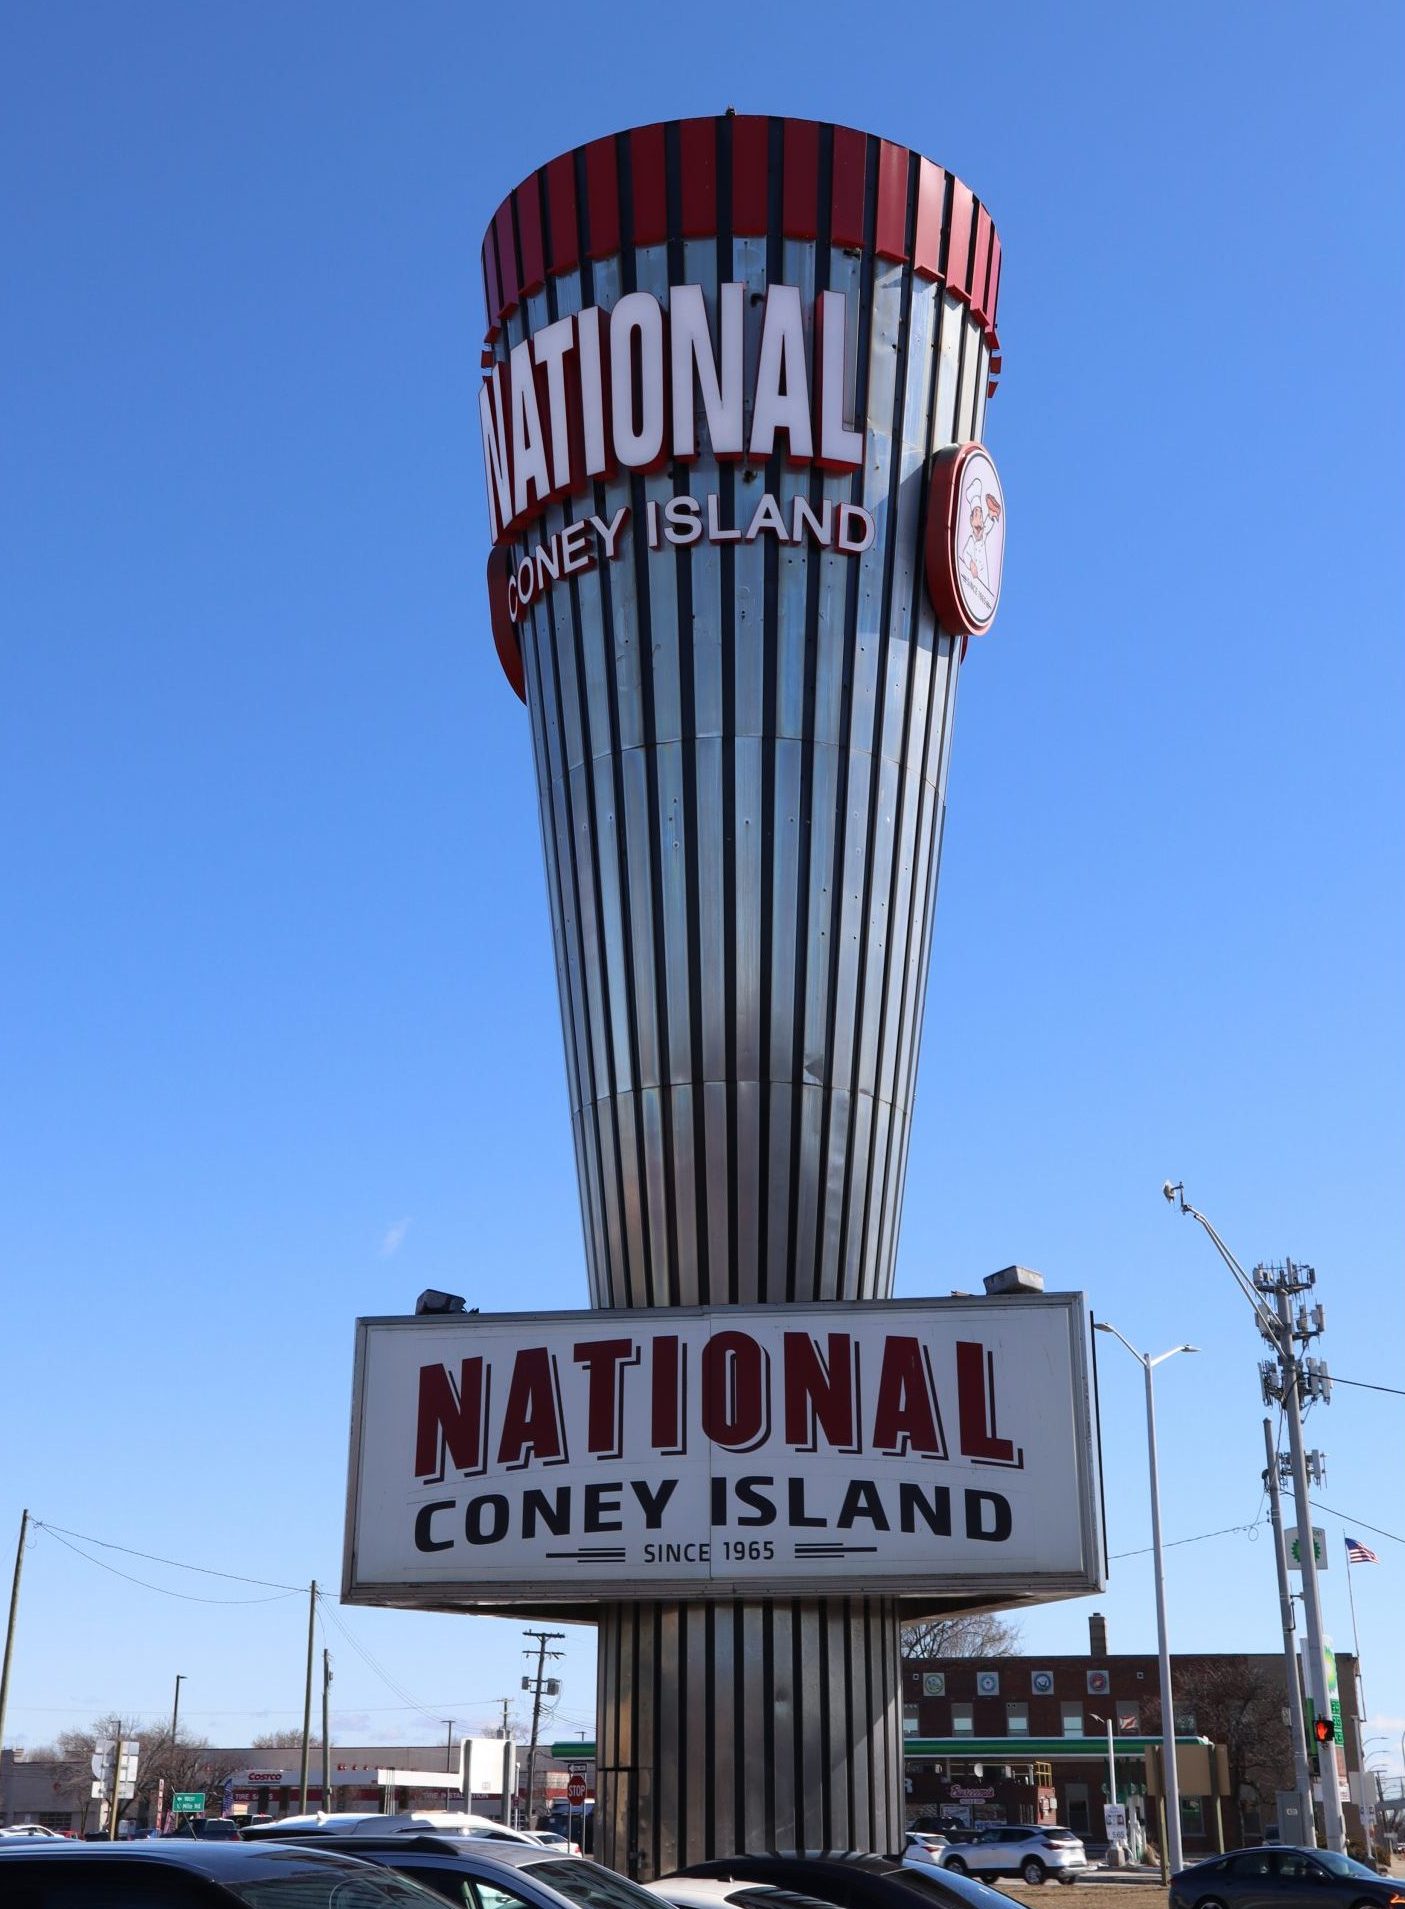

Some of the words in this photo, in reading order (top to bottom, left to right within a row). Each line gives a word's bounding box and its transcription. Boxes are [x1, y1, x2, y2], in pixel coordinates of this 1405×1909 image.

[478, 282, 863, 546] NATIONAL
[508, 507, 628, 623] CONEY
[647, 493, 877, 553] ISLAND
[414, 1330, 1024, 1485] NATIONAL
[414, 1479, 678, 1553] CONEY
[711, 1475, 1013, 1543] ISLAND
[643, 1543, 711, 1564] SINCE
[723, 1540, 776, 1562] 1965
[569, 1785, 586, 1797] STOP
